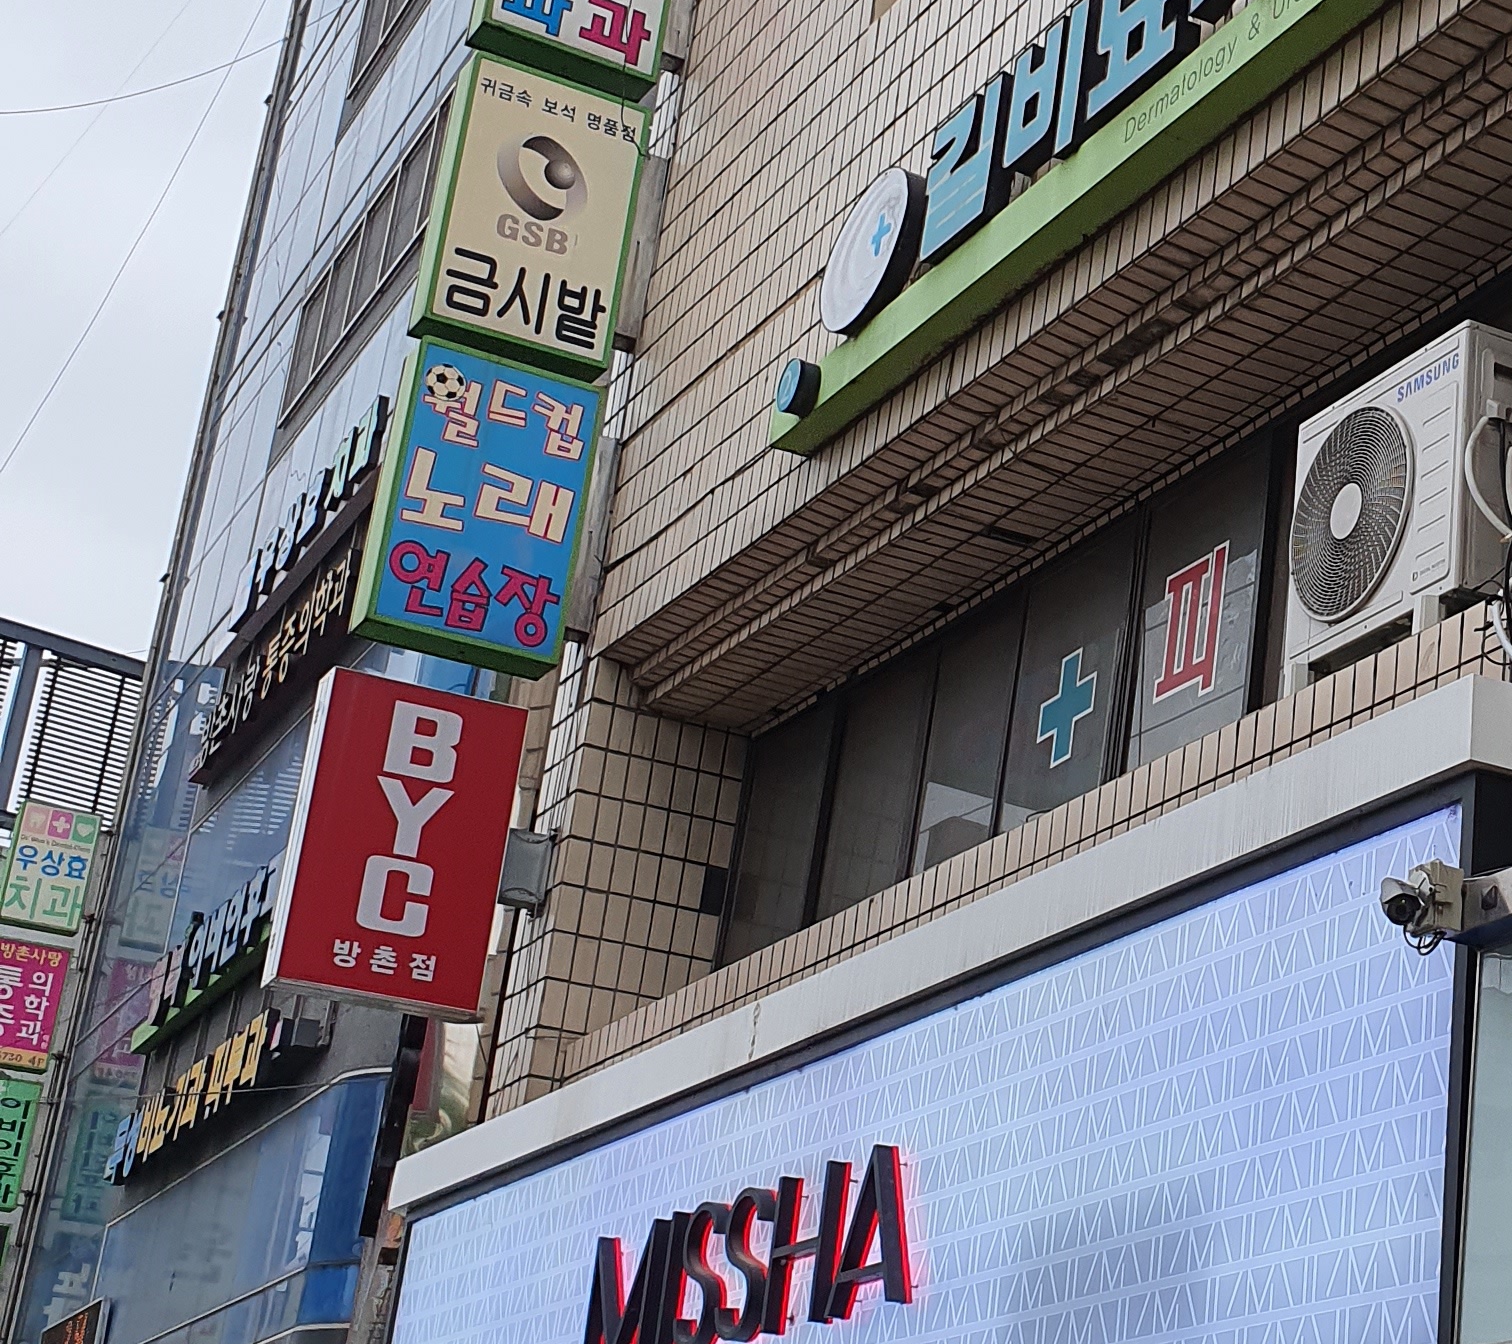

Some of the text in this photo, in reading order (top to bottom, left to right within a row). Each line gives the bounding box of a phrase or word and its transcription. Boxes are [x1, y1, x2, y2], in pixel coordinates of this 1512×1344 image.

[480, 76, 637, 142] 귀금속 보석 명품점
[1123, 38, 1239, 144] Dermatology
[1247, 14, 1262, 40] &
[496, 213, 569, 256] GSB
[444, 247, 606, 351] 금시밭
[423, 373, 584, 461] 월드컵
[1397, 352, 1460, 404] SAMSUNG
[401, 446, 575, 544] 노래
[389, 540, 560, 648] 연습장
[1153, 540, 1230, 703] 피
[356, 700, 463, 937] BYC
[4, 876, 82, 927] 치과
[16, 844, 89, 880] 우상효
[332, 938, 436, 982] 방촌점
[16, 970, 54, 1046] 의학과
